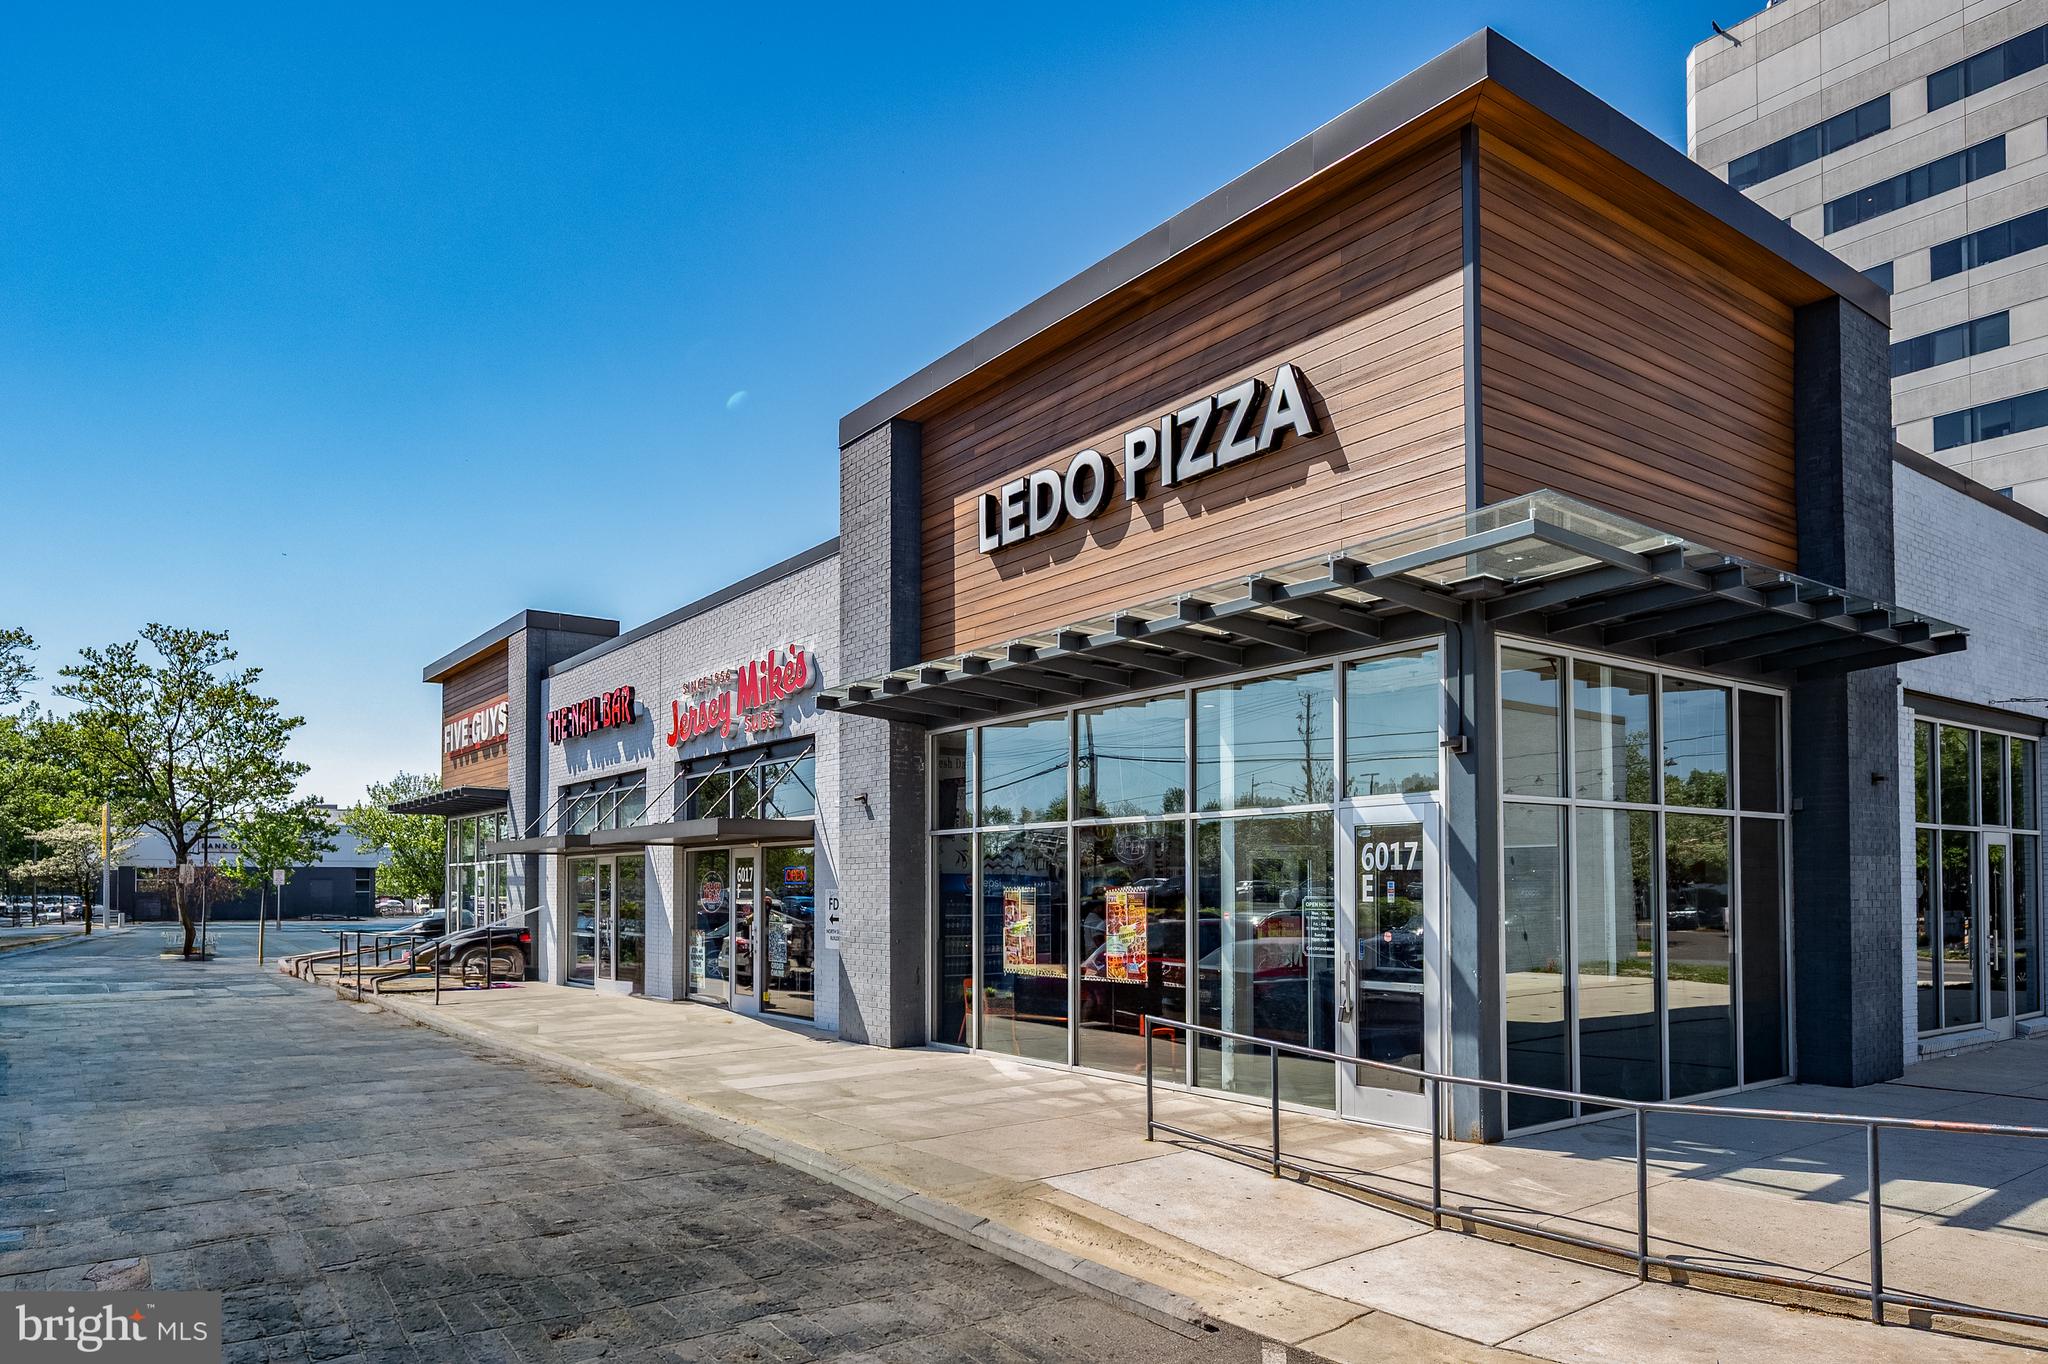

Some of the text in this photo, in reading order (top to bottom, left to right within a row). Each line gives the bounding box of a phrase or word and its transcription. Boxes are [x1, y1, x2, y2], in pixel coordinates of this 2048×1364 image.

[978, 363, 1315, 554] LEDO PIZZA
[683, 676, 709, 695] SINCE
[736, 643, 808, 717] Mike's
[444, 701, 508, 753] FIVE GUYS
[546, 685, 632, 744] THE NAIL BAR
[666, 691, 732, 748] Jersey
[744, 708, 777, 734] SUBS
[1361, 841, 1419, 871] 6017
[737, 867, 753, 882] 6017
[785, 869, 806, 881] OPEN
[1362, 874, 1374, 902] E
[737, 884, 741, 898] F
[829, 897, 839, 910] FD
